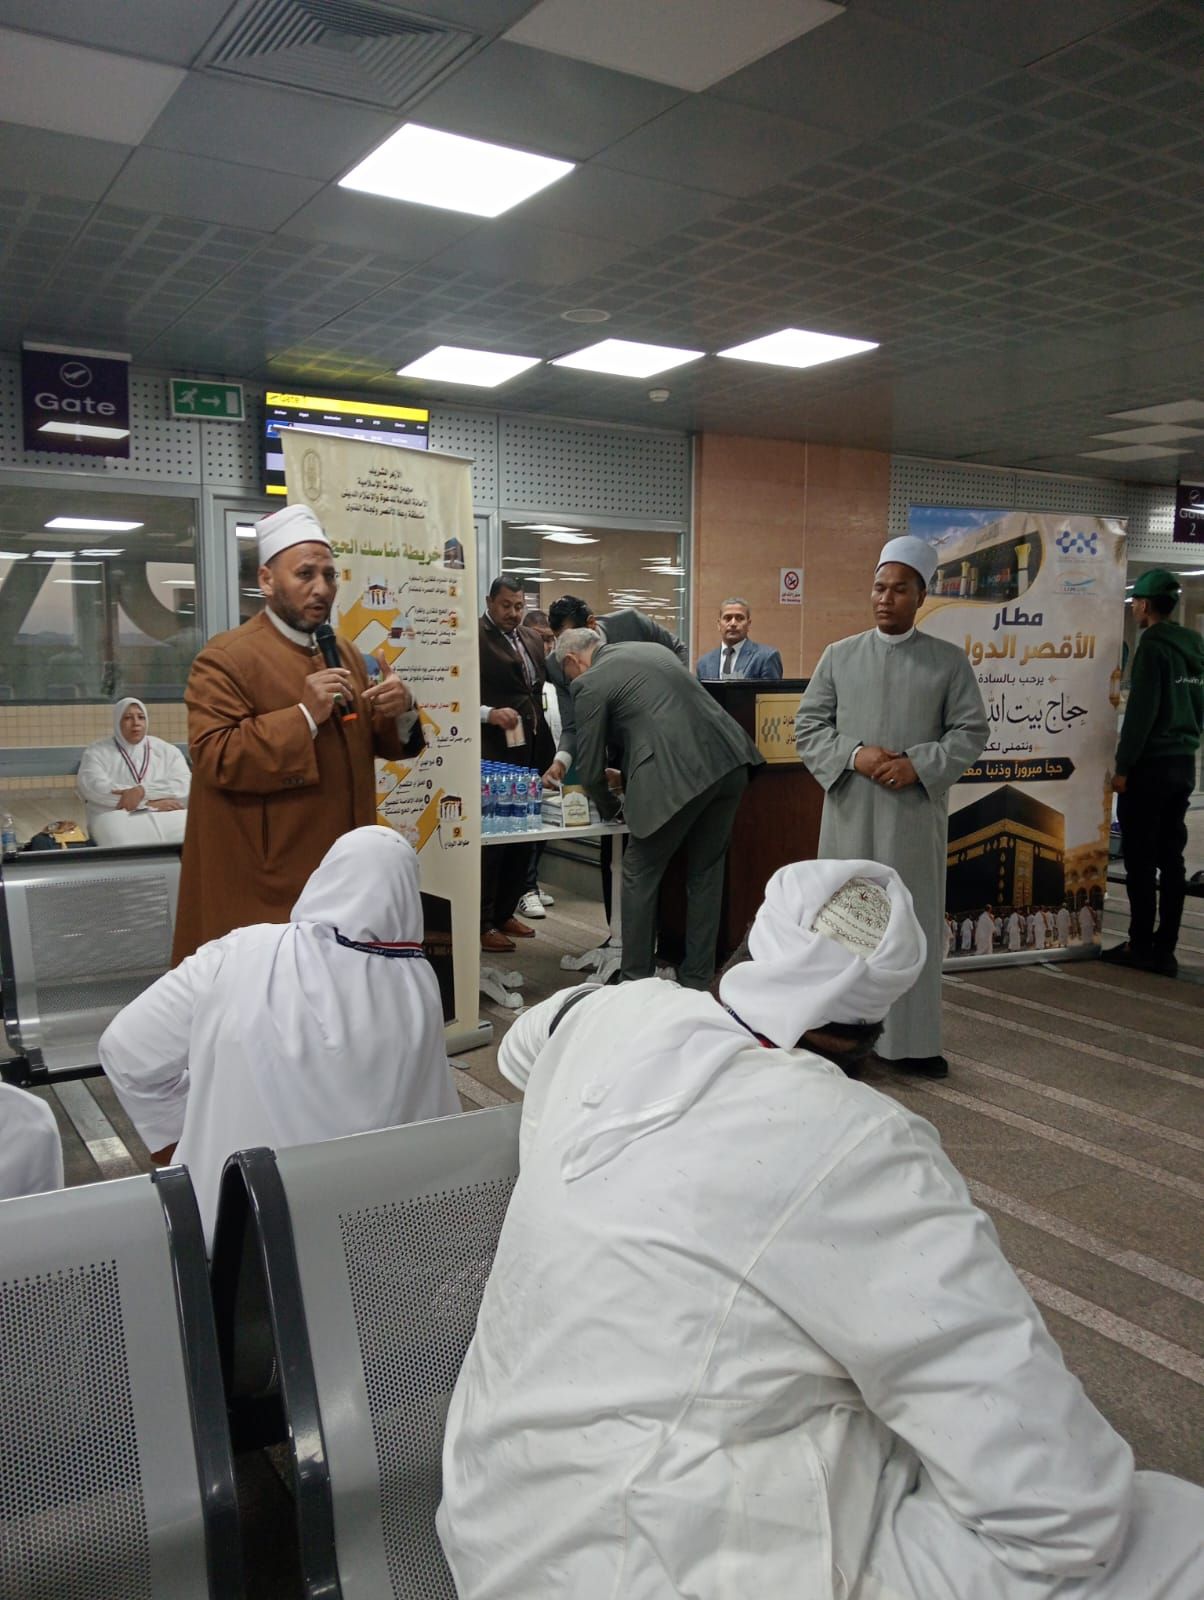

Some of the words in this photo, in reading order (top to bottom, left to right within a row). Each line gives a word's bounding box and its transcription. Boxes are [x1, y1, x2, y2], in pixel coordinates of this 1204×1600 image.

[34, 392, 116, 416] Gate
[1190, 522, 1196, 537] 2
[331, 537, 359, 559] الحج
[360, 539, 400, 559] مناسك
[403, 542, 442, 566] خريطة
[449, 586, 457, 597] 2
[450, 617, 458, 628] 3
[992, 606, 1043, 632] مطار
[964, 633, 1017, 667] الدول
[1018, 631, 1096, 666] الأقصر
[978, 672, 1016, 686] بالسادة
[1018, 675, 1045, 686] يرحب
[1006, 702, 1043, 730] بيت
[1002, 741, 1033, 755] ونتمنى
[453, 827, 461, 838] 9
